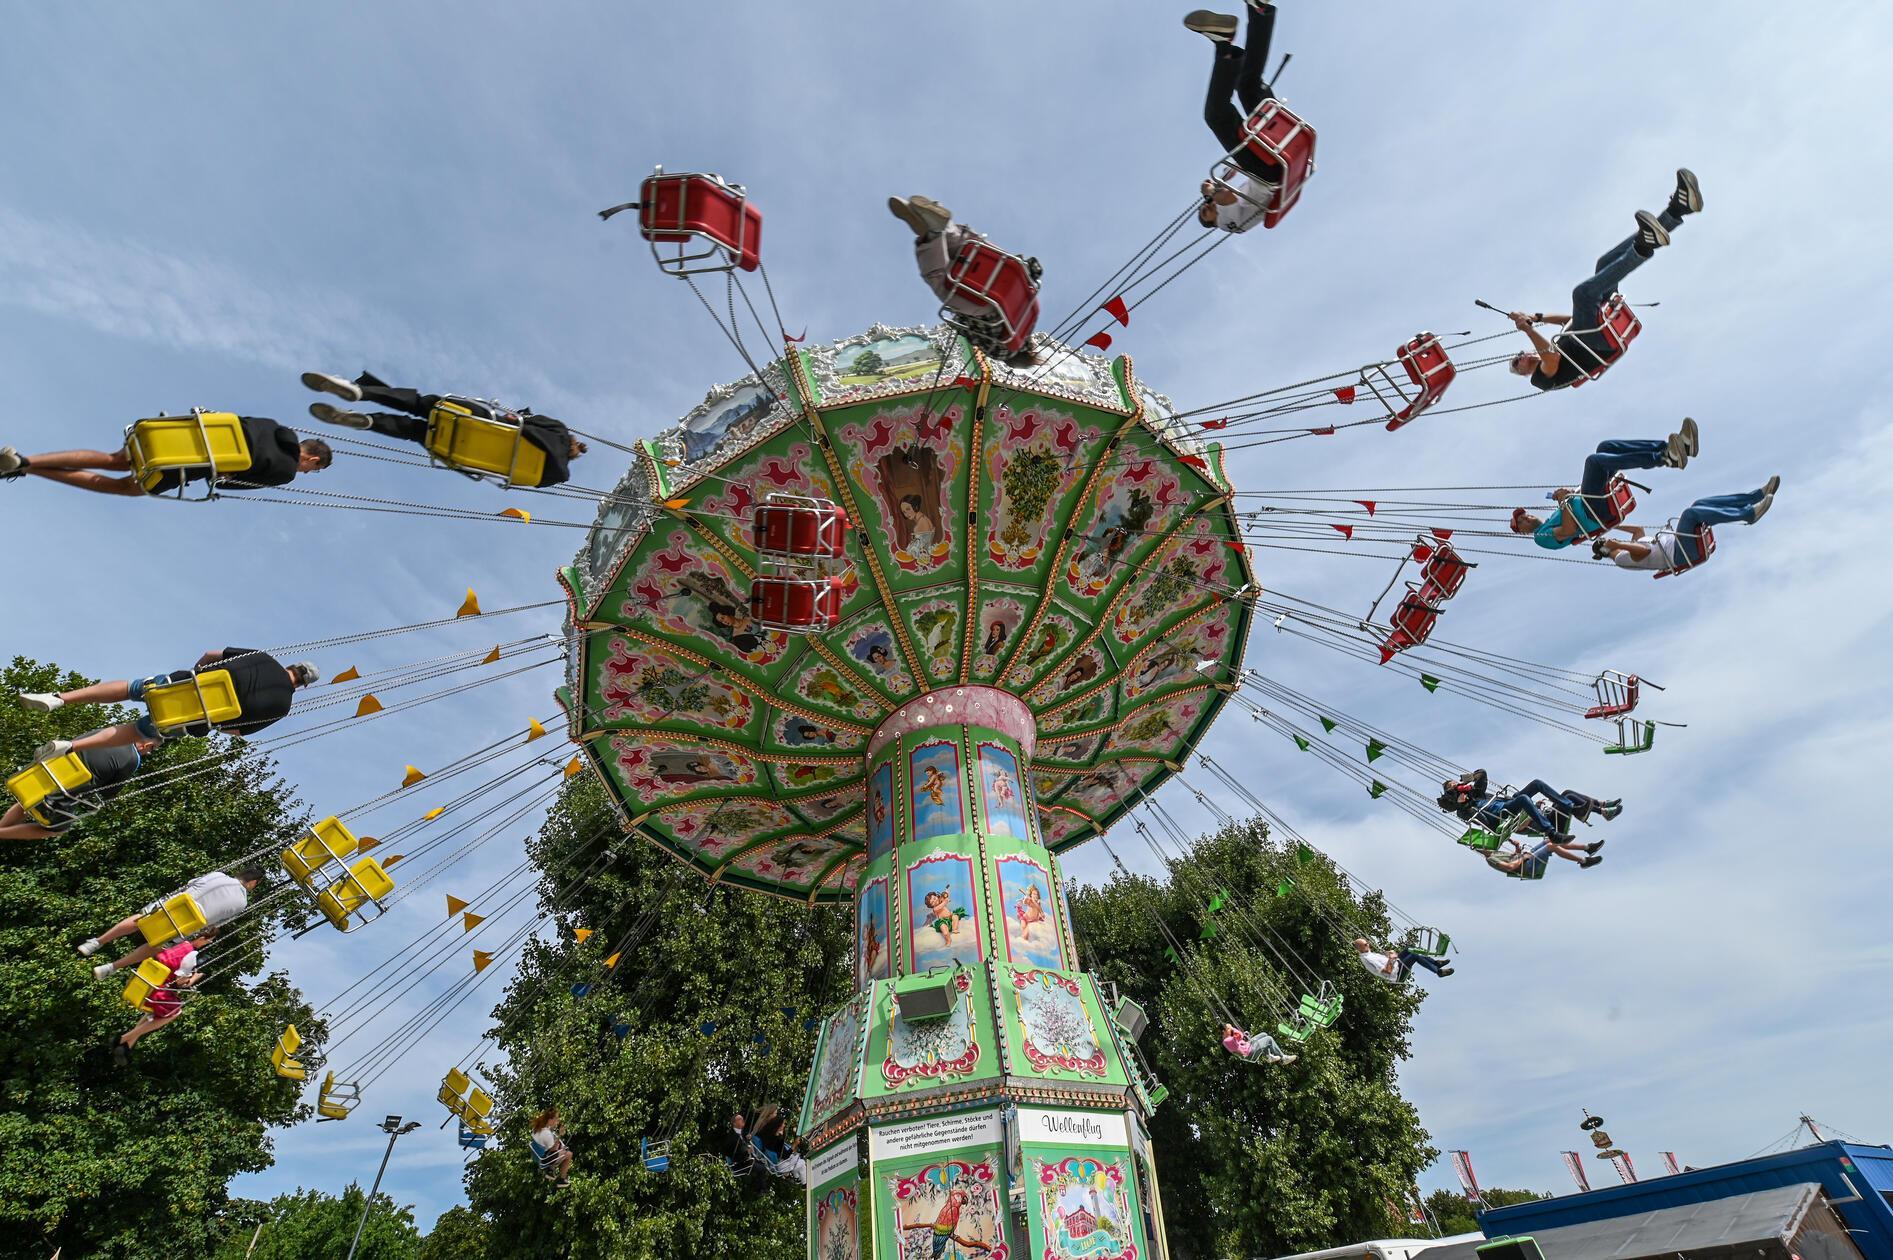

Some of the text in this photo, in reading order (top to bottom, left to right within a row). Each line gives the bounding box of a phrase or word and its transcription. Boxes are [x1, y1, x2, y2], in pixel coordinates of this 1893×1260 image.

[879, 1127, 900, 1137] Rauchen
[901, 1124, 926, 1134] verboten!
[964, 1116, 982, 1124] Stöcke
[982, 1113, 993, 1121] und
[886, 1123, 987, 1144] andere gefährliche Gegenstände dürfen
[1042, 1114, 1102, 1139] Wellenflug
[913, 1138, 951, 1150] mitgenommen
[951, 1133, 974, 1143] werden!
